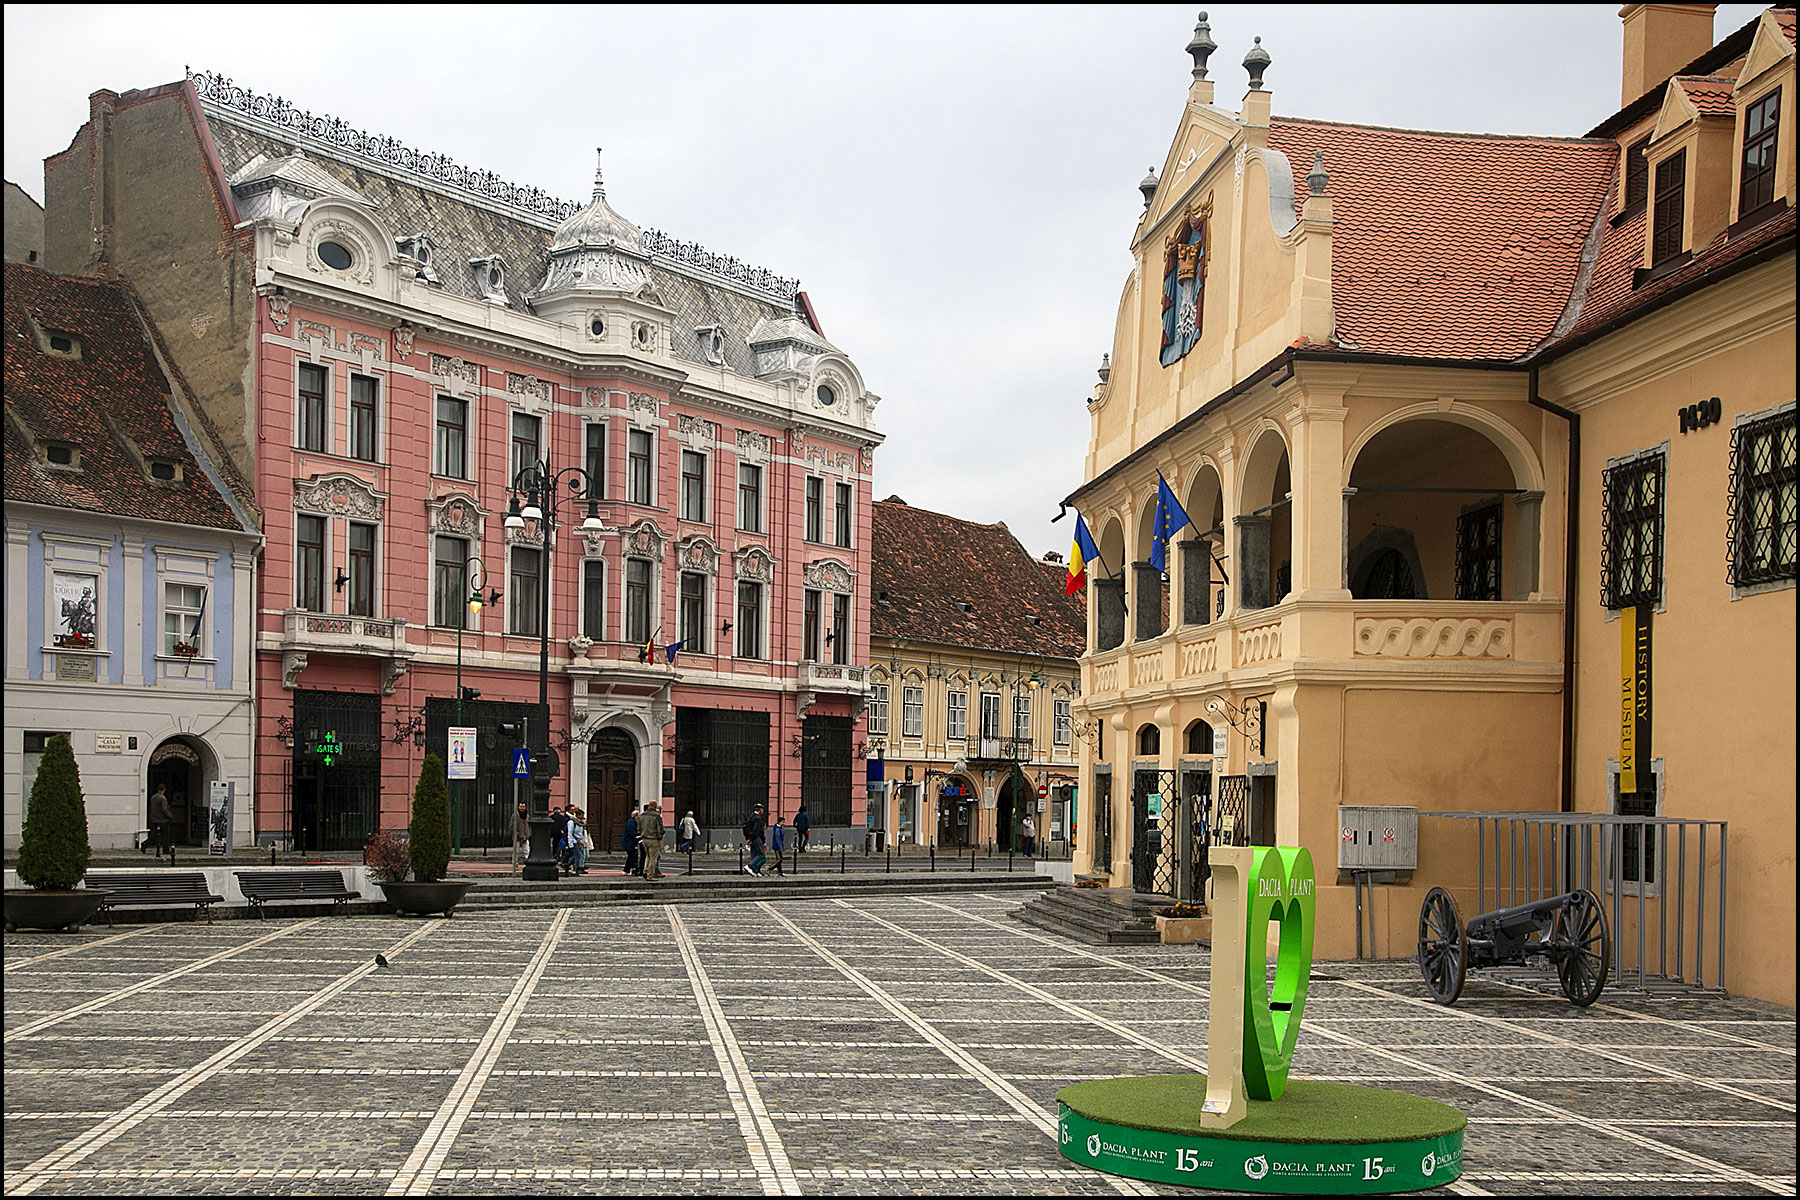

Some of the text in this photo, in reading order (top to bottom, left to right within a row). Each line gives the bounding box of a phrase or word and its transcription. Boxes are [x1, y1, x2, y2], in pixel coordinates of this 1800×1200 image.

[1678, 397, 1721, 434] 1420
[1637, 626, 1648, 721] HISTORY
[1622, 677, 1632, 771] MUSEUM
[945, 787, 959, 796] BCR
[1259, 878, 1282, 897] DACIA
[1102, 1141, 1128, 1154] DACIA
[1175, 1148, 1214, 1172] 15 ani
[1273, 1162, 1309, 1172] DACIA
[1362, 1157, 1396, 1181] 15 ani
[1436, 1154, 1452, 1165] DACIA
